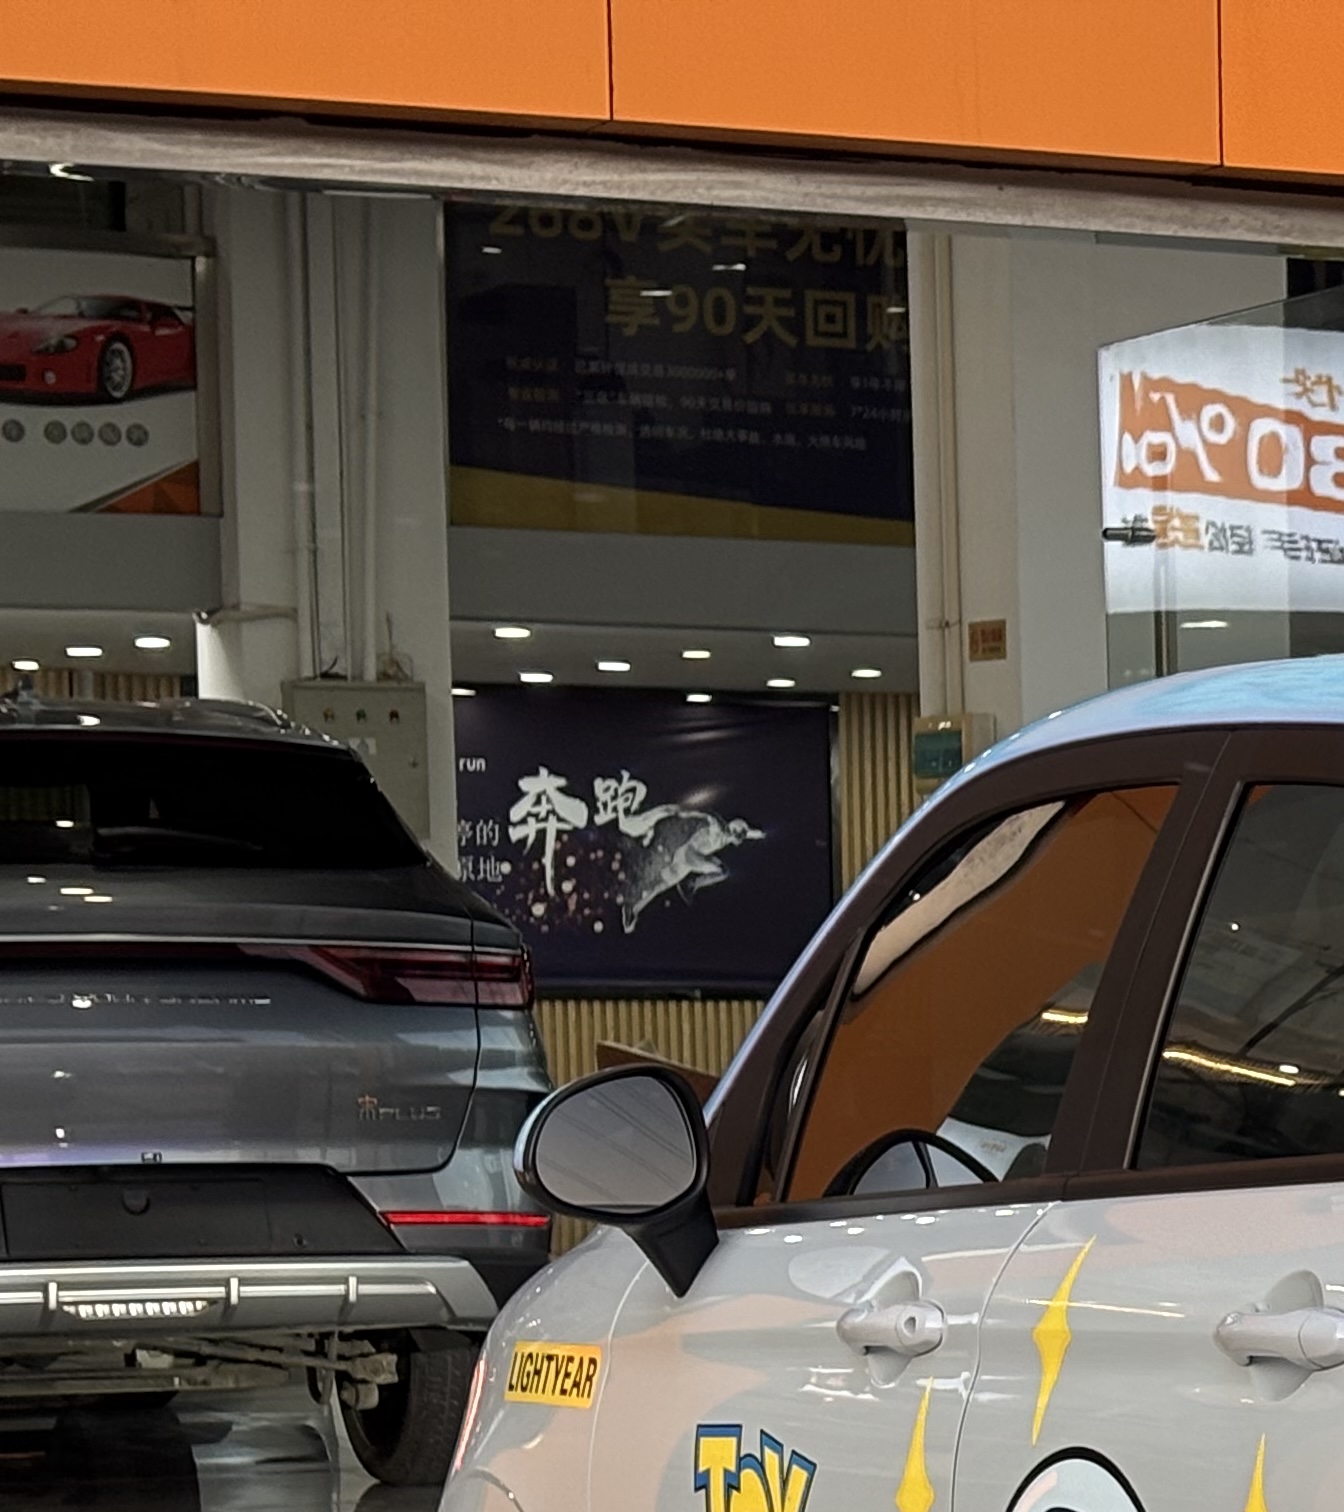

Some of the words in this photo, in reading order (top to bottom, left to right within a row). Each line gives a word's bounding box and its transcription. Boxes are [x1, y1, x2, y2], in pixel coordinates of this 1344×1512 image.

[458, 756, 487, 772] run
[508, 764, 656, 897] 奔跑
[507, 1350, 599, 1400] LIGHTYEAR
